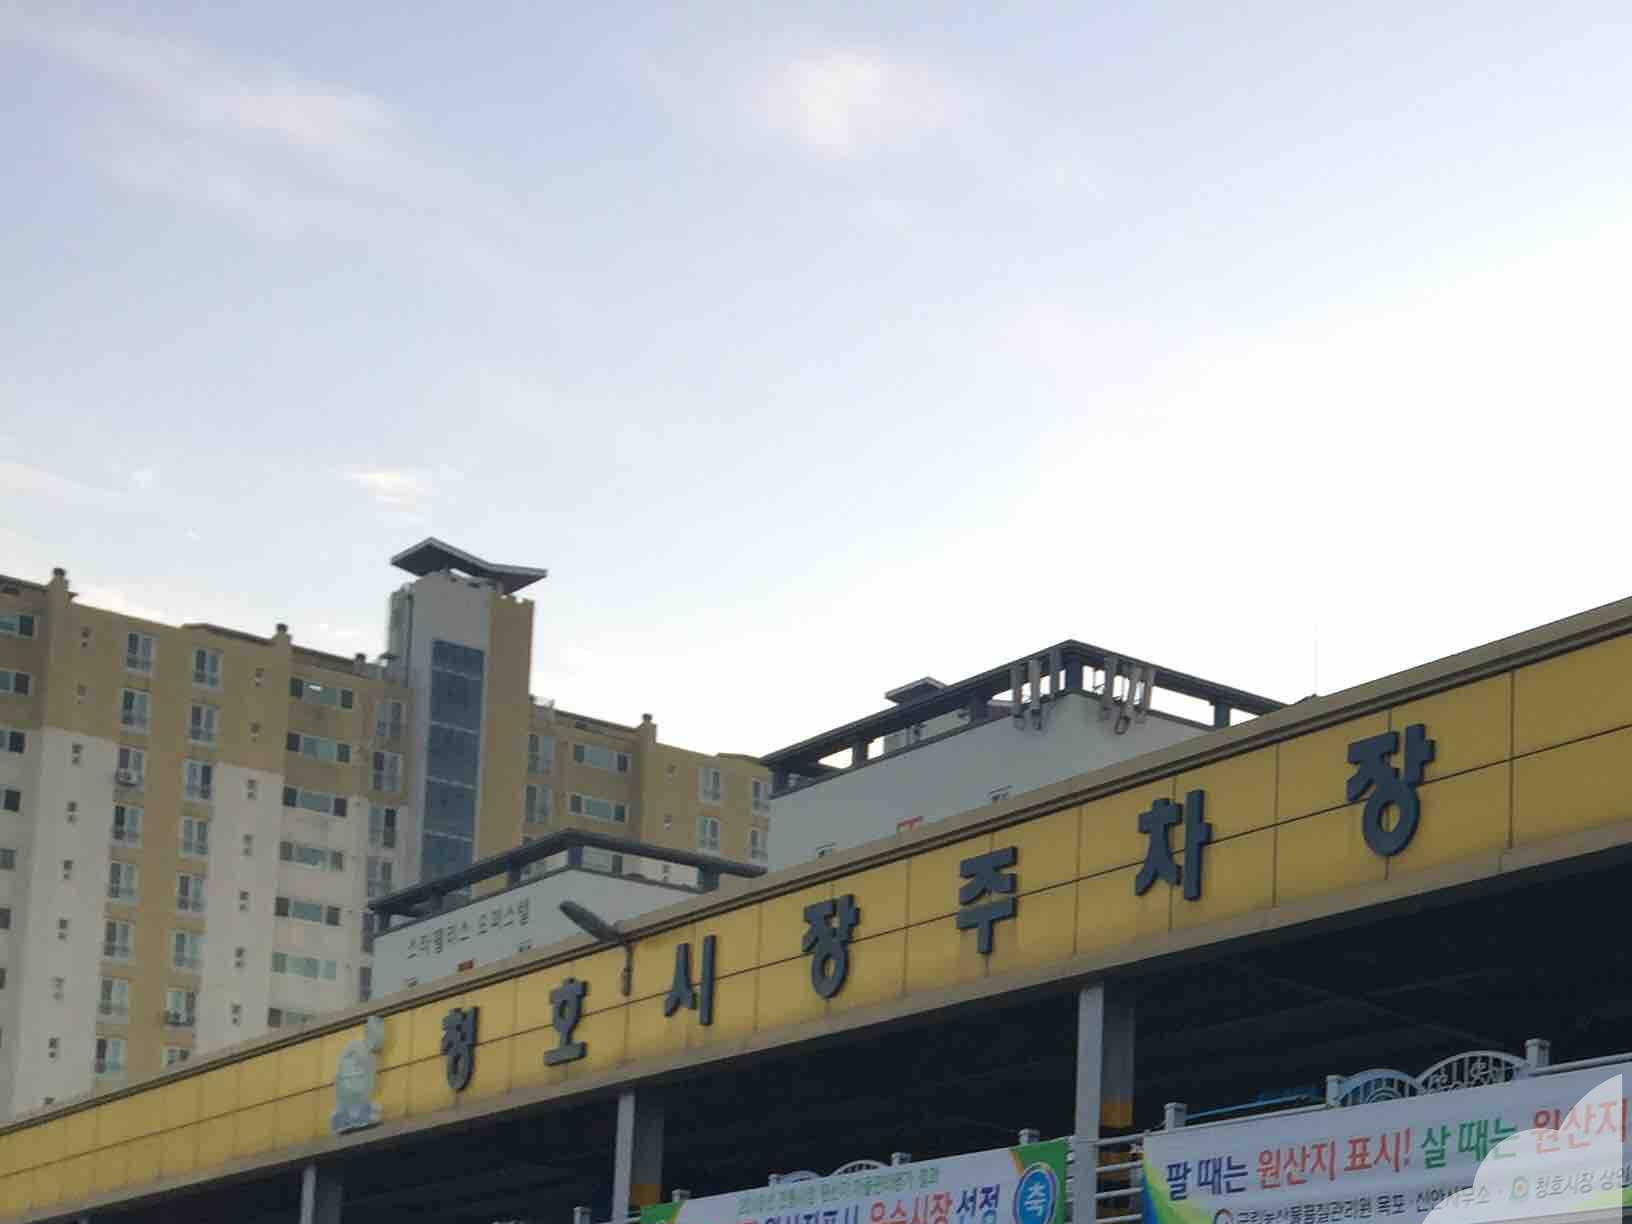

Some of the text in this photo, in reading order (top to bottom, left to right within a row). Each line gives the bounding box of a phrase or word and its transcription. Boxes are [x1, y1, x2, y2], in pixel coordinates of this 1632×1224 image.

[1166, 1160, 1191, 1201] 팔
[1197, 1154, 1249, 1196] 때는
[1256, 1137, 1336, 1190] 원산지
[1344, 1127, 1413, 1173] 표시!
[1421, 1127, 1452, 1169] 살
[1457, 1117, 1519, 1162] 때는
[1532, 1099, 1628, 1154] 원산지
